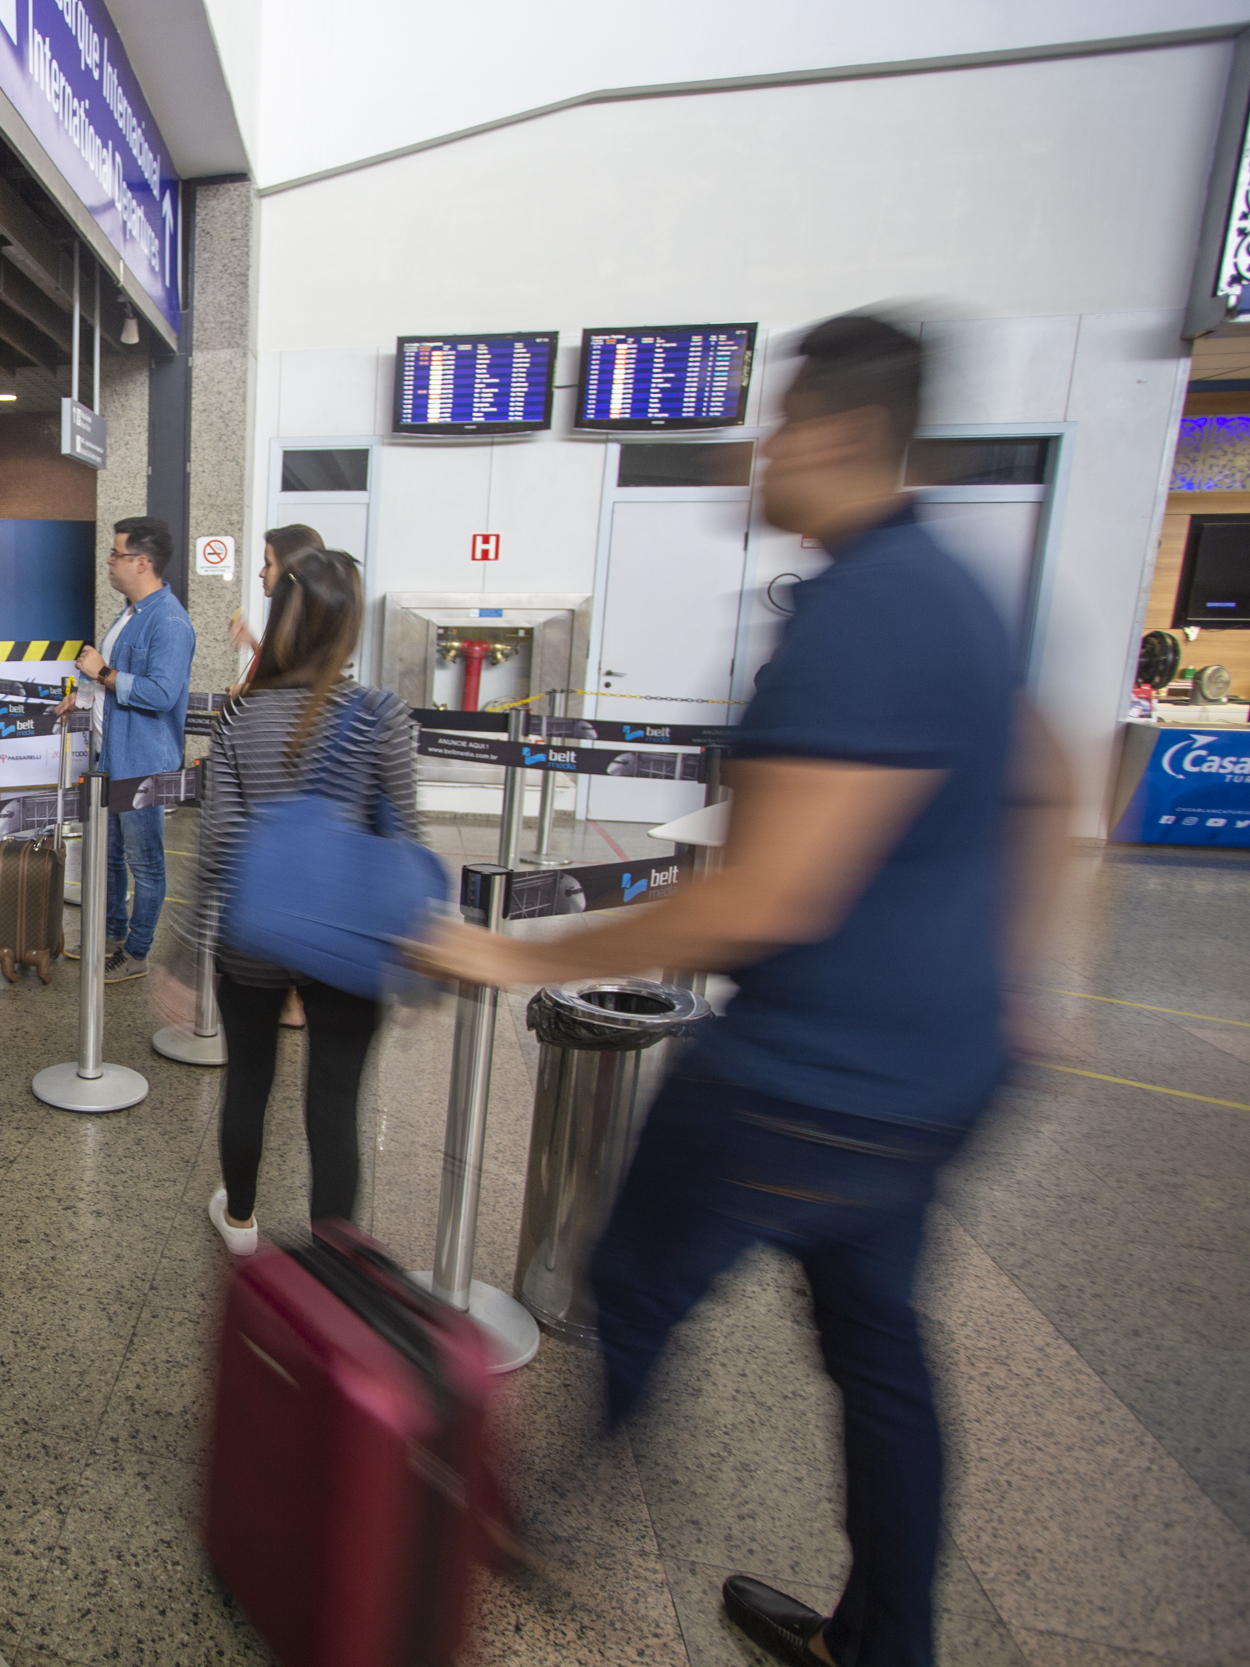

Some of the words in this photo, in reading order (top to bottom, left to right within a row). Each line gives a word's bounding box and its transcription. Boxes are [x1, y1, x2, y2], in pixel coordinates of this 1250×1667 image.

[55, 0, 100, 81] arque
[103, 36, 161, 201] Internacional
[27, 0, 113, 197] International
[114, 150, 160, 273] Departures
[474, 535, 497, 560] H
[8, 704, 25, 714] belt
[16, 719, 34, 730] belt
[646, 725, 671, 738] belt
[16, 729, 35, 737] media
[437, 737, 467, 749] ANUNCIE
[468, 741, 485, 750] AQUI
[427, 746, 498, 761] www.beltmedia.com.br
[548, 749, 577, 764] belt
[547, 761, 577, 771] media
[650, 865, 679, 887] belt
